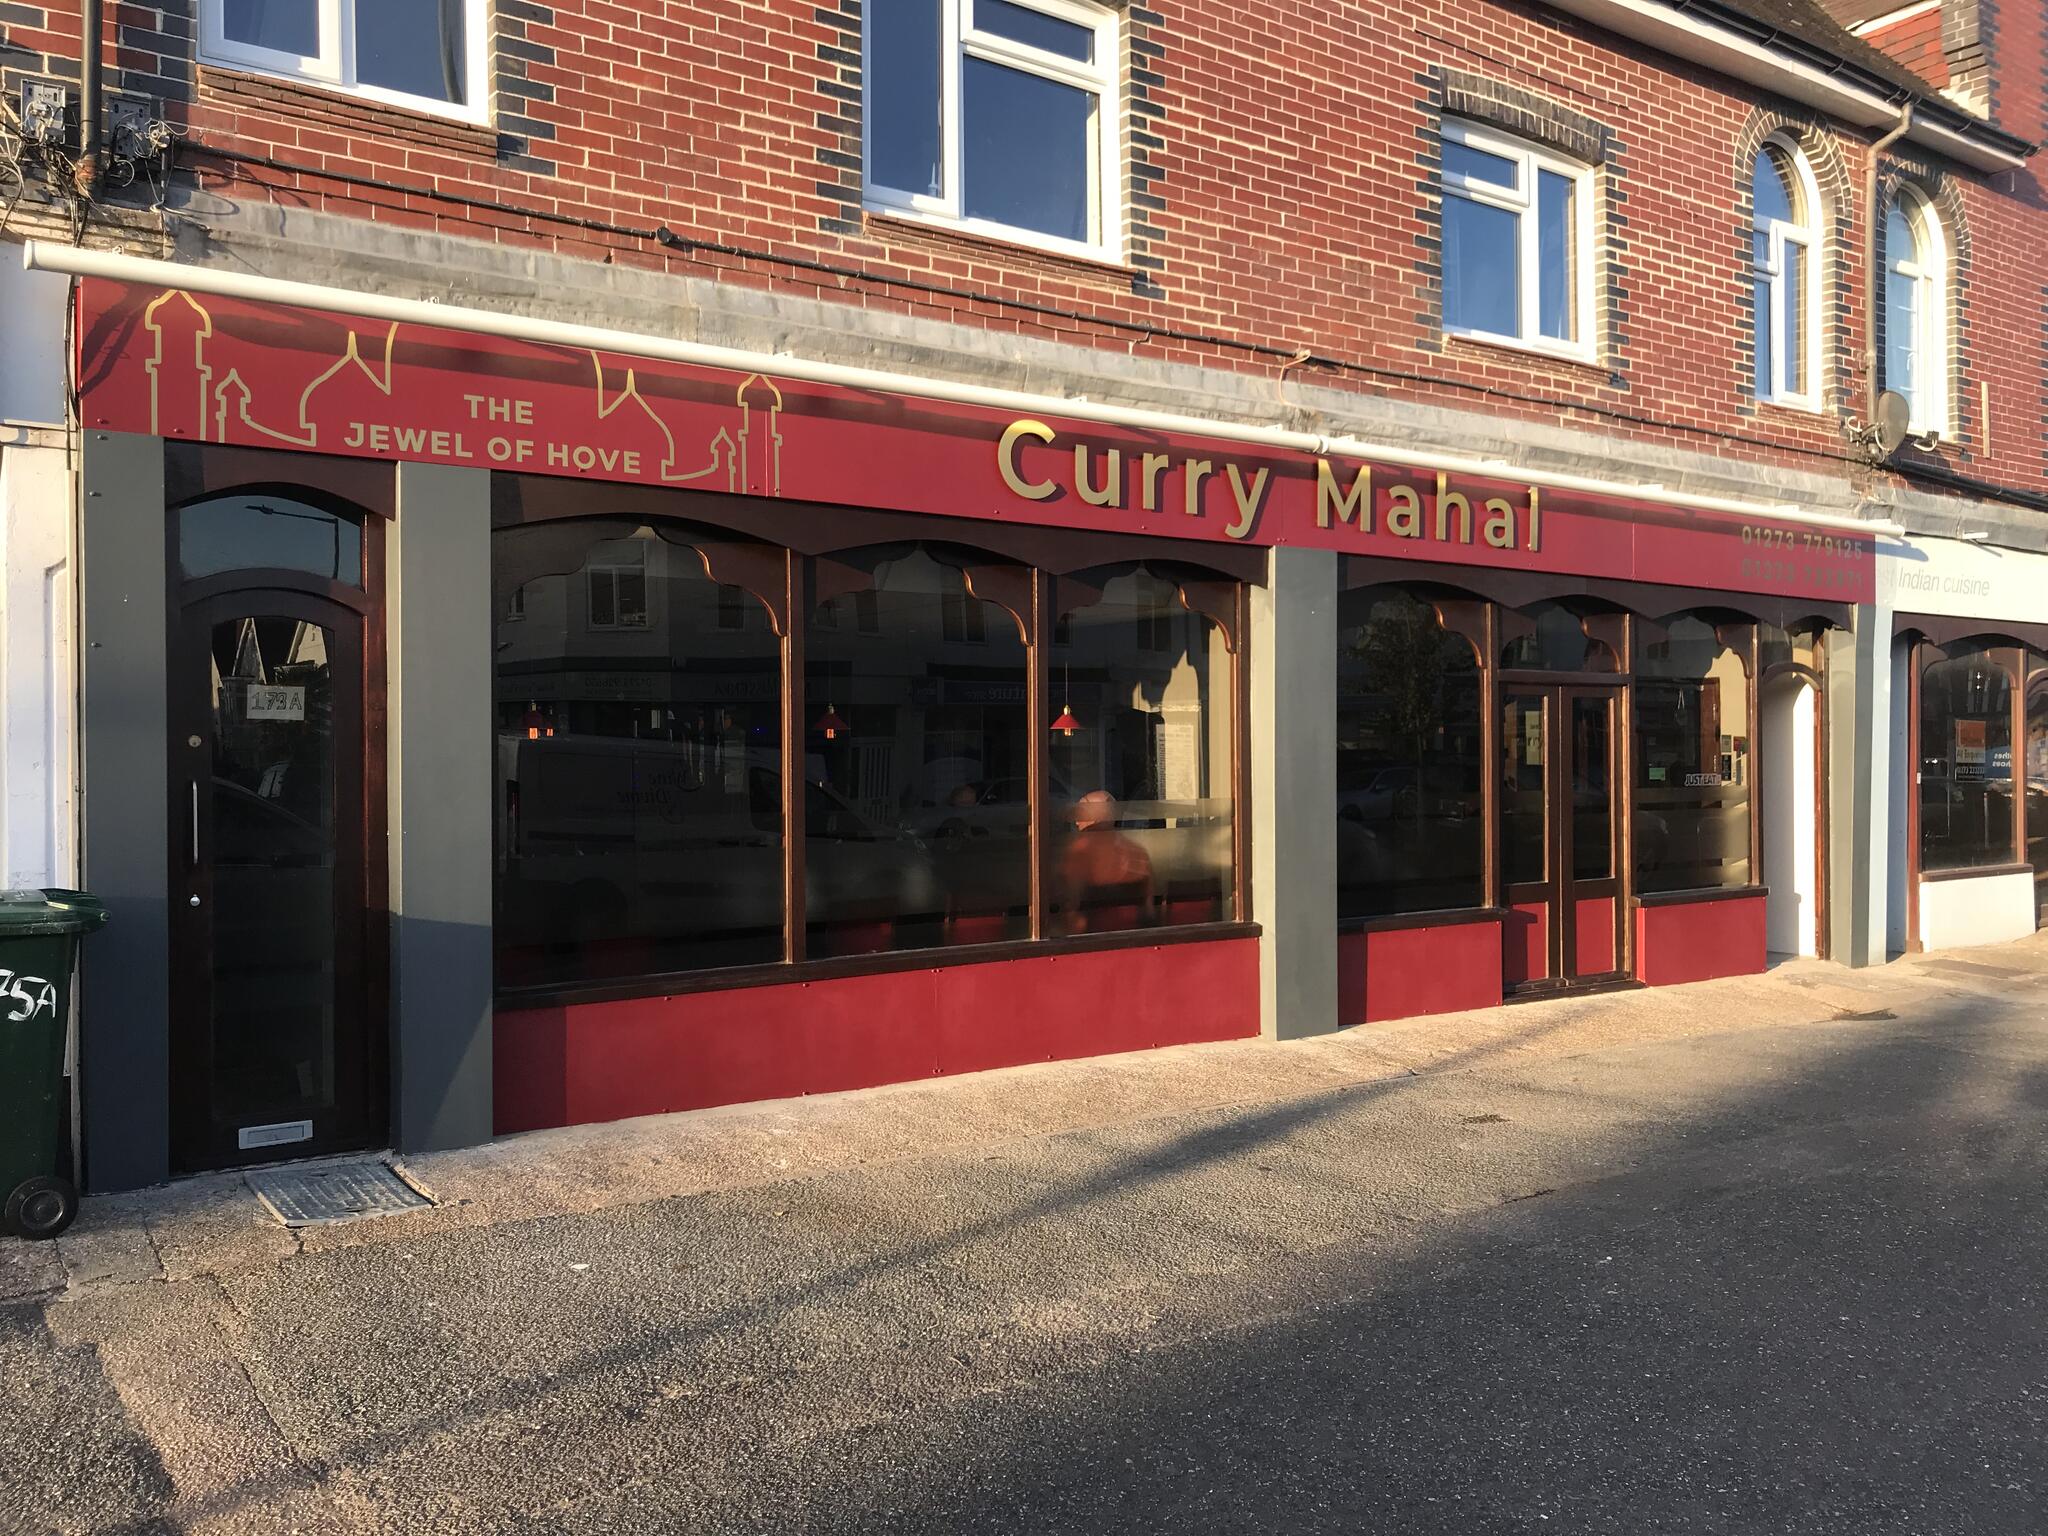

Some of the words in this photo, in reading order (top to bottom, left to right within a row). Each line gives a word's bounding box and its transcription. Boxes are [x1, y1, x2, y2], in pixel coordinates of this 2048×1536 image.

[463, 394, 534, 424] THE
[344, 422, 473, 458] JEWEL
[487, 437, 534, 463] OF
[547, 442, 641, 475] HOVE
[997, 419, 1269, 539] Curry
[1316, 458, 1540, 552] Mahal
[1742, 525, 1794, 551] 01273
[1803, 533, 1863, 560] 779125
[1898, 567, 1940, 592] Indian
[1943, 574, 1990, 597] cuisine
[1685, 774, 1702, 785] JUST
[1703, 774, 1716, 785] EAT
